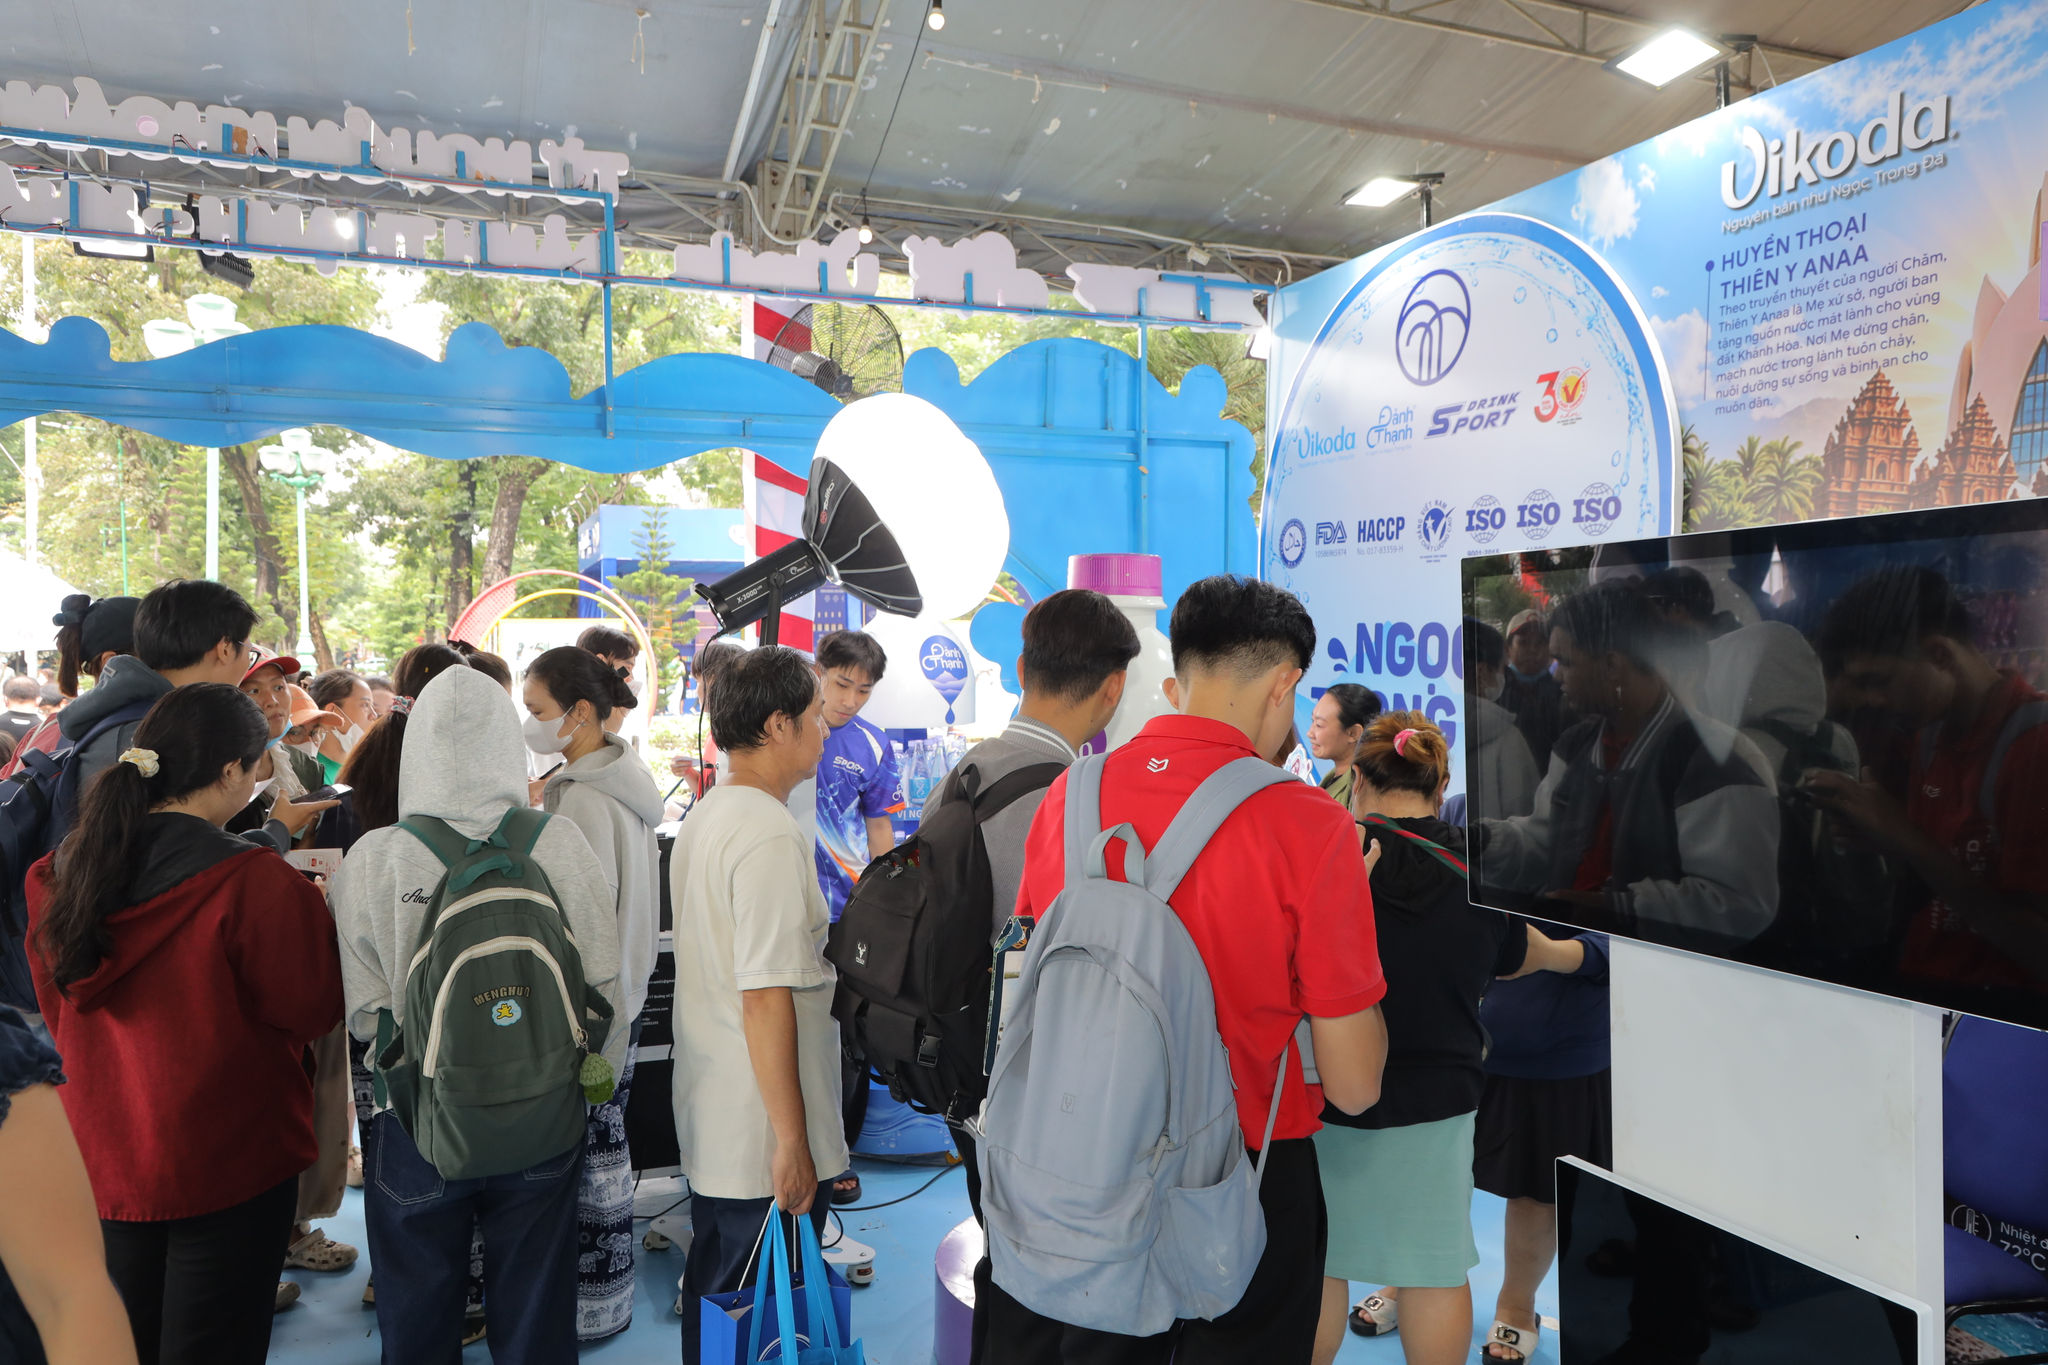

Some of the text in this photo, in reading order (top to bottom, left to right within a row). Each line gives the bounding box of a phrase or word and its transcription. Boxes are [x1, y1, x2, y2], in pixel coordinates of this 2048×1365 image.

[1721, 91, 1949, 209] Vikoda
[1721, 152, 1946, 234] Nguyên bản như Ngọc Trong Đá
[1722, 212, 1867, 272] HUYỀN THOẠI
[1720, 244, 1869, 299] THIÊN Y ANAA
[1718, 318, 1748, 333] Thiên
[1751, 314, 1758, 325] Y
[1760, 308, 1790, 323] Anaa
[1792, 303, 1802, 316] là
[1806, 299, 1825, 313] Mẹ
[1828, 293, 1845, 308] xứ
[1869, 277, 1908, 299] người
[1911, 273, 1938, 288] ban
[1720, 302, 1746, 317] Theo
[1790, 278, 1829, 299] thuyết
[1833, 273, 1856, 289] của
[1859, 261, 1898, 283] người
[1718, 336, 1742, 352] tặng
[1784, 319, 1814, 334] nước
[1818, 312, 1842, 328] mát
[1845, 305, 1873, 321] lành
[1876, 300, 1902, 314] cho
[1905, 291, 1941, 307] vùng
[1717, 351, 1735, 367] đất
[1738, 344, 1773, 361] Khánh
[1806, 332, 1827, 347] Nơi
[1830, 329, 1850, 343] Mẹ
[1853, 321, 1888, 337] dừng
[1715, 351, 1929, 399] nuôi dưỡng sự sống và bình an cho
[1716, 367, 1747, 383] mạch
[1749, 360, 1778, 377] nước
[1781, 355, 1814, 369] trong
[1817, 348, 1843, 363] lành
[1847, 341, 1877, 357] tuôn
[1467, 391, 1521, 412] DRINK
[1715, 396, 1773, 415] muôn dân.
[1425, 403, 1517, 438] SPORT
[1298, 426, 1356, 459] Vikoda
[1465, 507, 1506, 532] ISO
[1516, 502, 1560, 528] ISO
[1572, 496, 1622, 523] ISO
[1315, 520, 1347, 545] FDA
[1357, 516, 1405, 543] HACCP
[833, 755, 865, 774] SPORT
[908, 809, 922, 818] NG
[2000, 1221, 2037, 1246] Nhiệt
